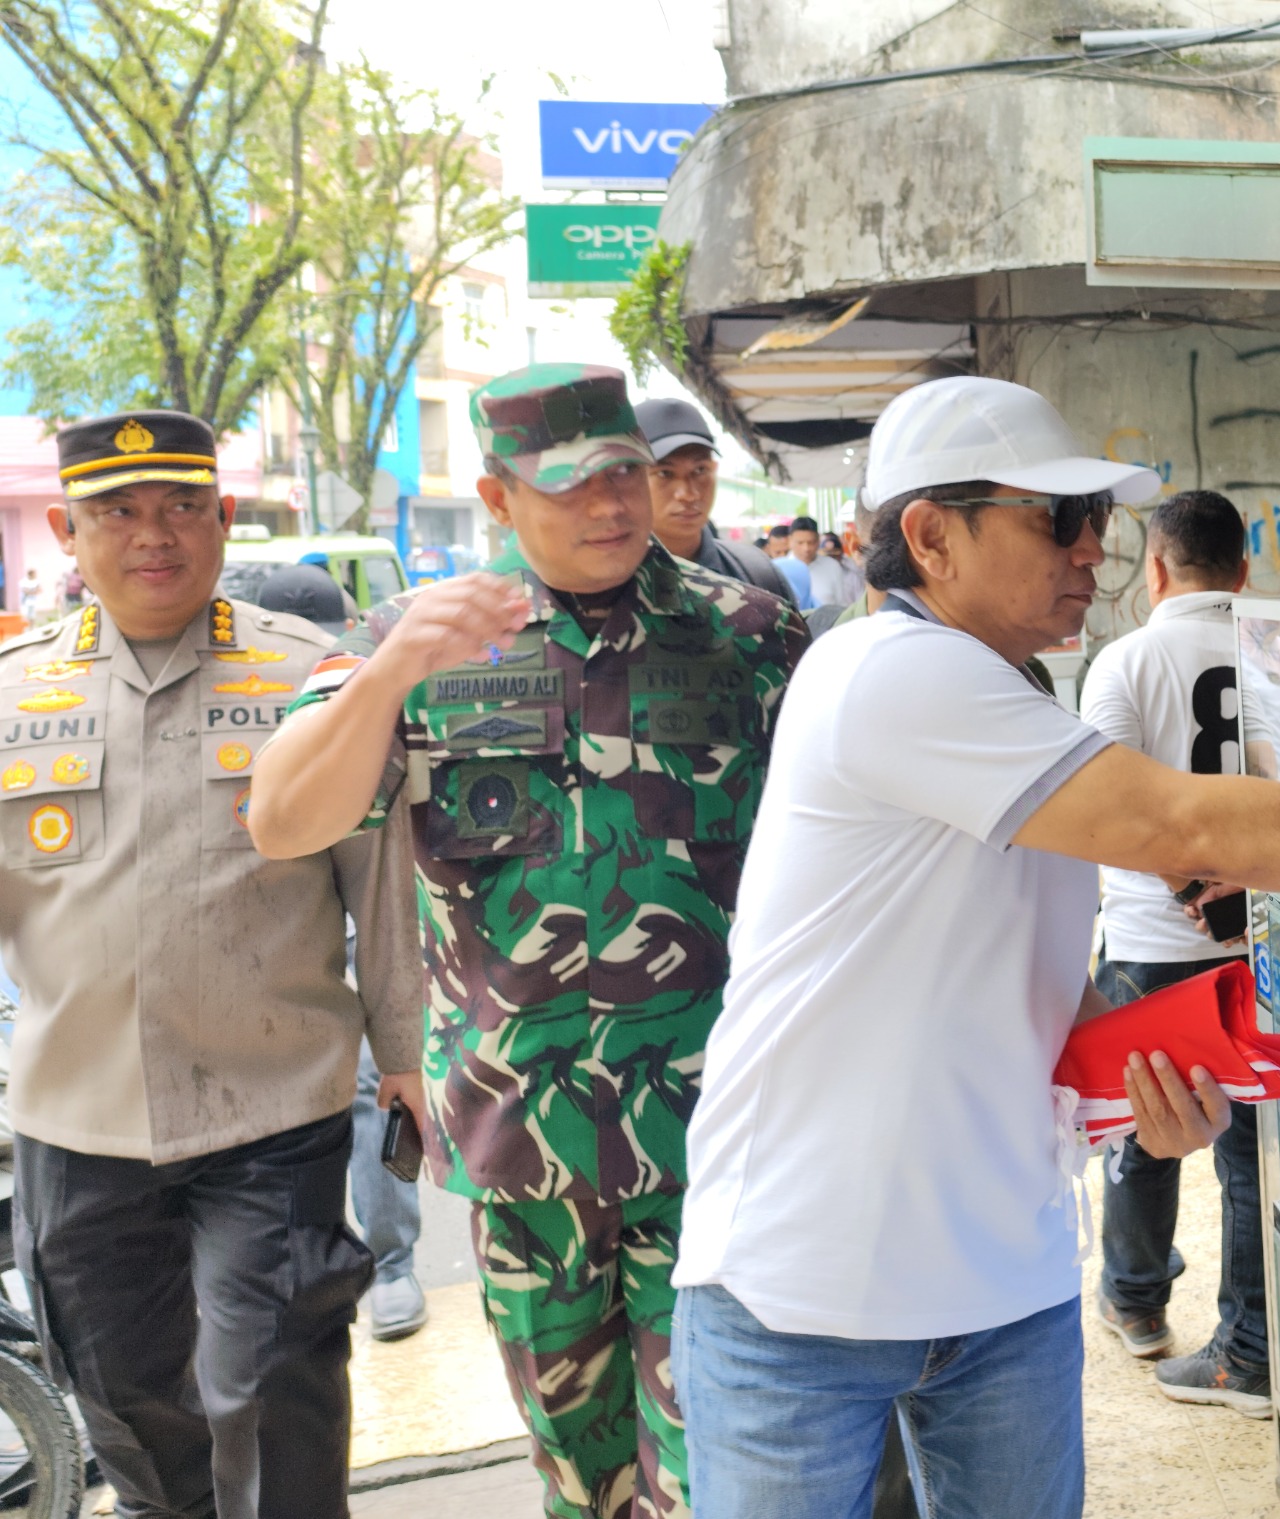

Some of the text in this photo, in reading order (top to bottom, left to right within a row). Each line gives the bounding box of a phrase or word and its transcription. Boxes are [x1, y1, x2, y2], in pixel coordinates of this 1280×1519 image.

[572, 120, 694, 154] vivo
[563, 224, 658, 248] opp
[577, 249, 625, 260] Camera
[436, 674, 558, 699] MUHAMMAD ALI
[642, 667, 744, 688] TNI AD
[4, 717, 96, 743] JUNI
